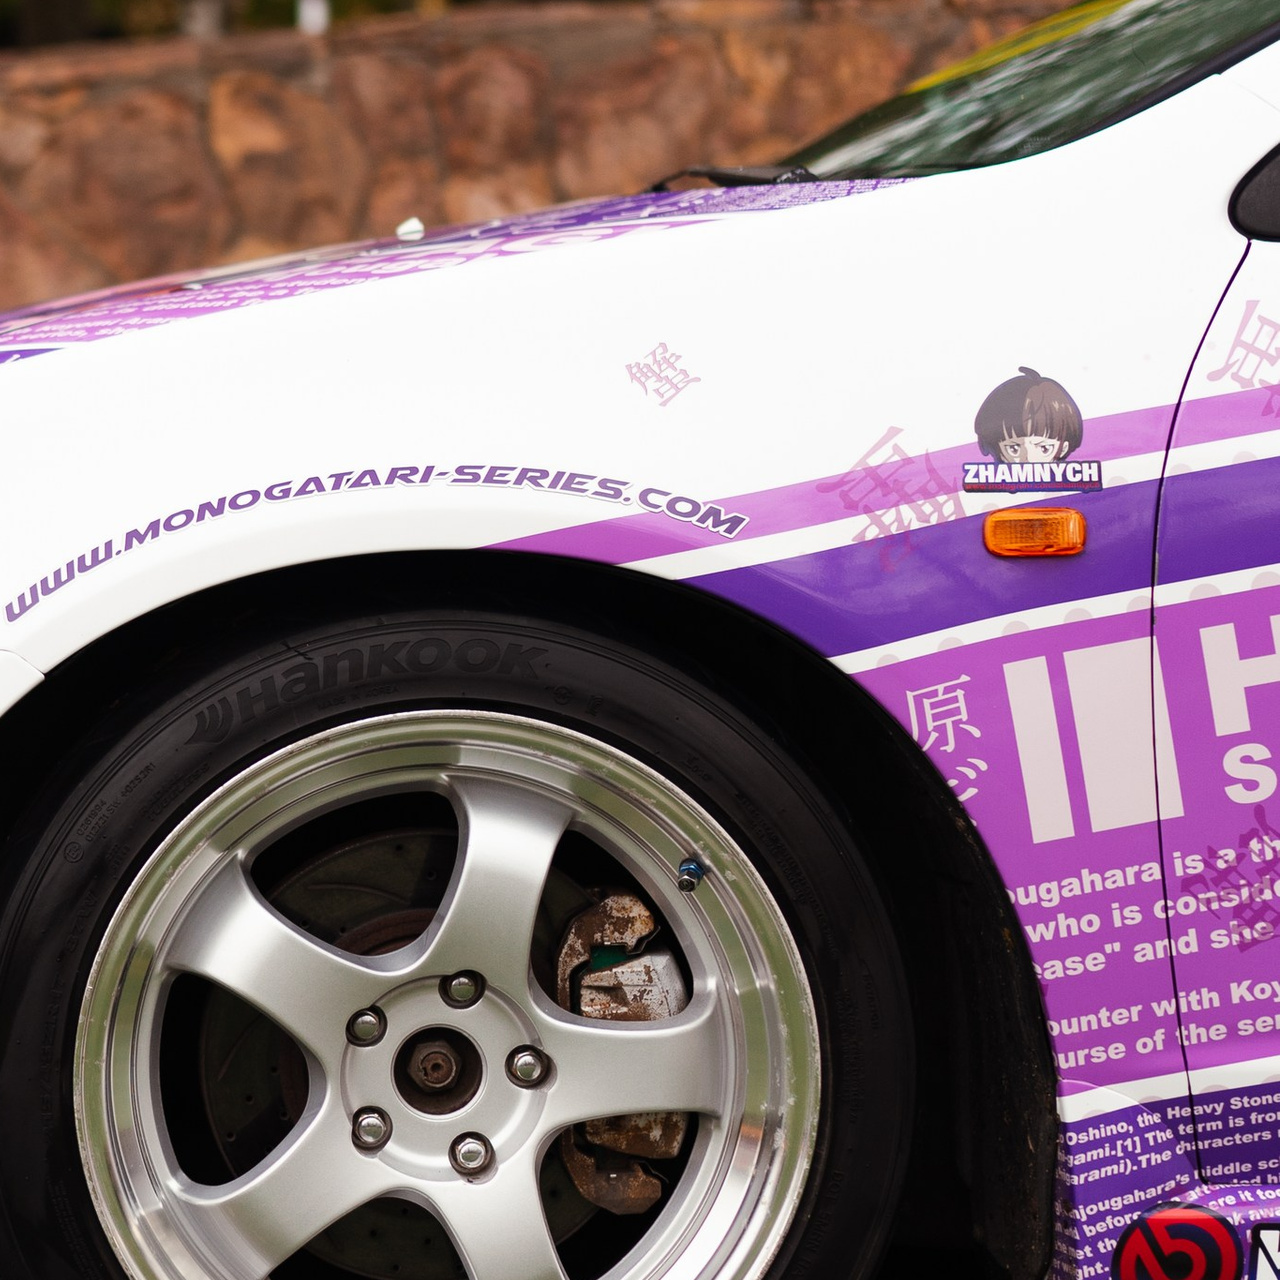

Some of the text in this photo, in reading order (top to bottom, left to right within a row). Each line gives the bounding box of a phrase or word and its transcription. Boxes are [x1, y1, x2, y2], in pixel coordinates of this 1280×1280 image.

[963, 462, 1099, 484] ZHAMNYCH
[1173, 851, 1205, 877] is
[1216, 848, 1236, 869] a
[1024, 912, 1101, 944] who
[1111, 902, 1143, 928] is
[1133, 928, 1199, 963] and
[1210, 920, 1274, 950] she
[1151, 987, 1221, 1018] with
[1053, 1041, 1127, 1071] urse
[1135, 1028, 1166, 1055] of
[1176, 1021, 1228, 1048] the
[1065, 1118, 1134, 1146] Oshino,
[1136, 1112, 1162, 1129] the
[1166, 1101, 1225, 1121] Heavy
[1144, 1127, 1175, 1147] The
[1177, 1117, 1224, 1136] term
[1228, 1116, 1246, 1128] is
[1175, 1130, 1273, 1156] characters
[1097, 1237, 1119, 1254] th
